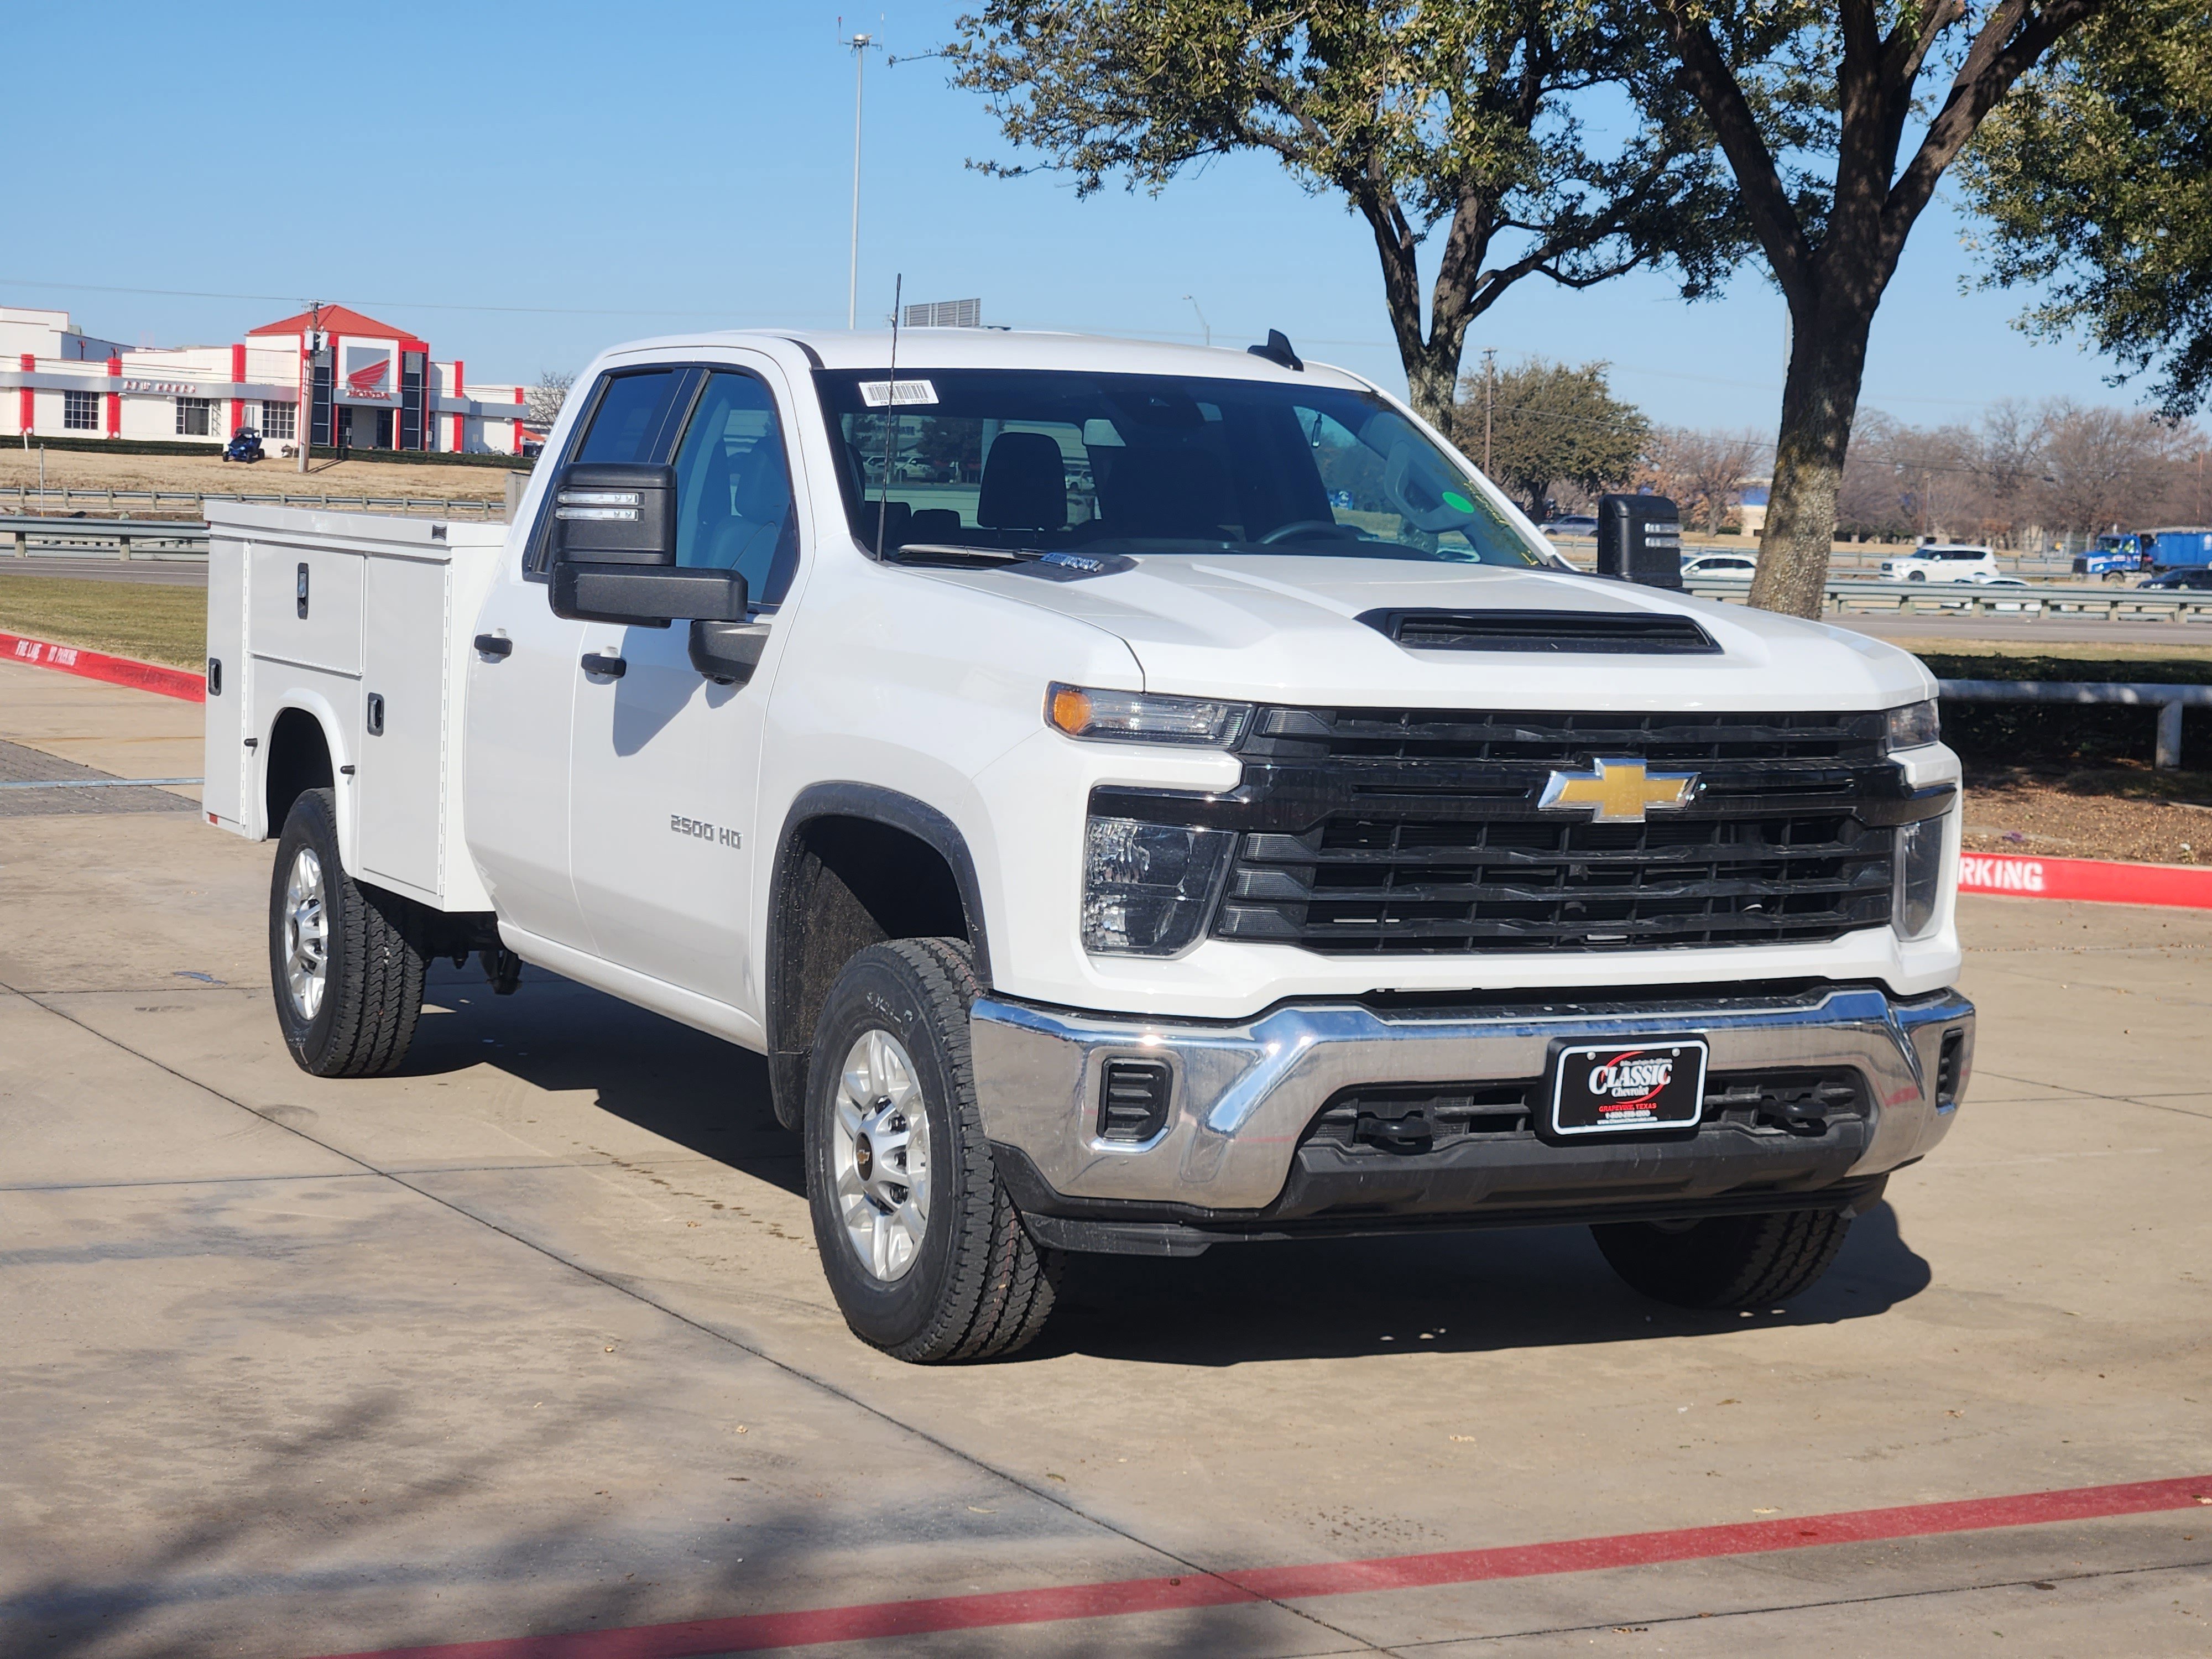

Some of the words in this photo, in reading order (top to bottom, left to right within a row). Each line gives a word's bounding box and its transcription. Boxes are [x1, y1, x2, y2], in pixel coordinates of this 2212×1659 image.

[346, 389, 392, 401] HONDA
[671, 814, 716, 842] 2500
[719, 827, 743, 850] HD
[1589, 1063, 1673, 1095] CLASSIC
[1611, 1086, 1650, 1098] Chevrolet
